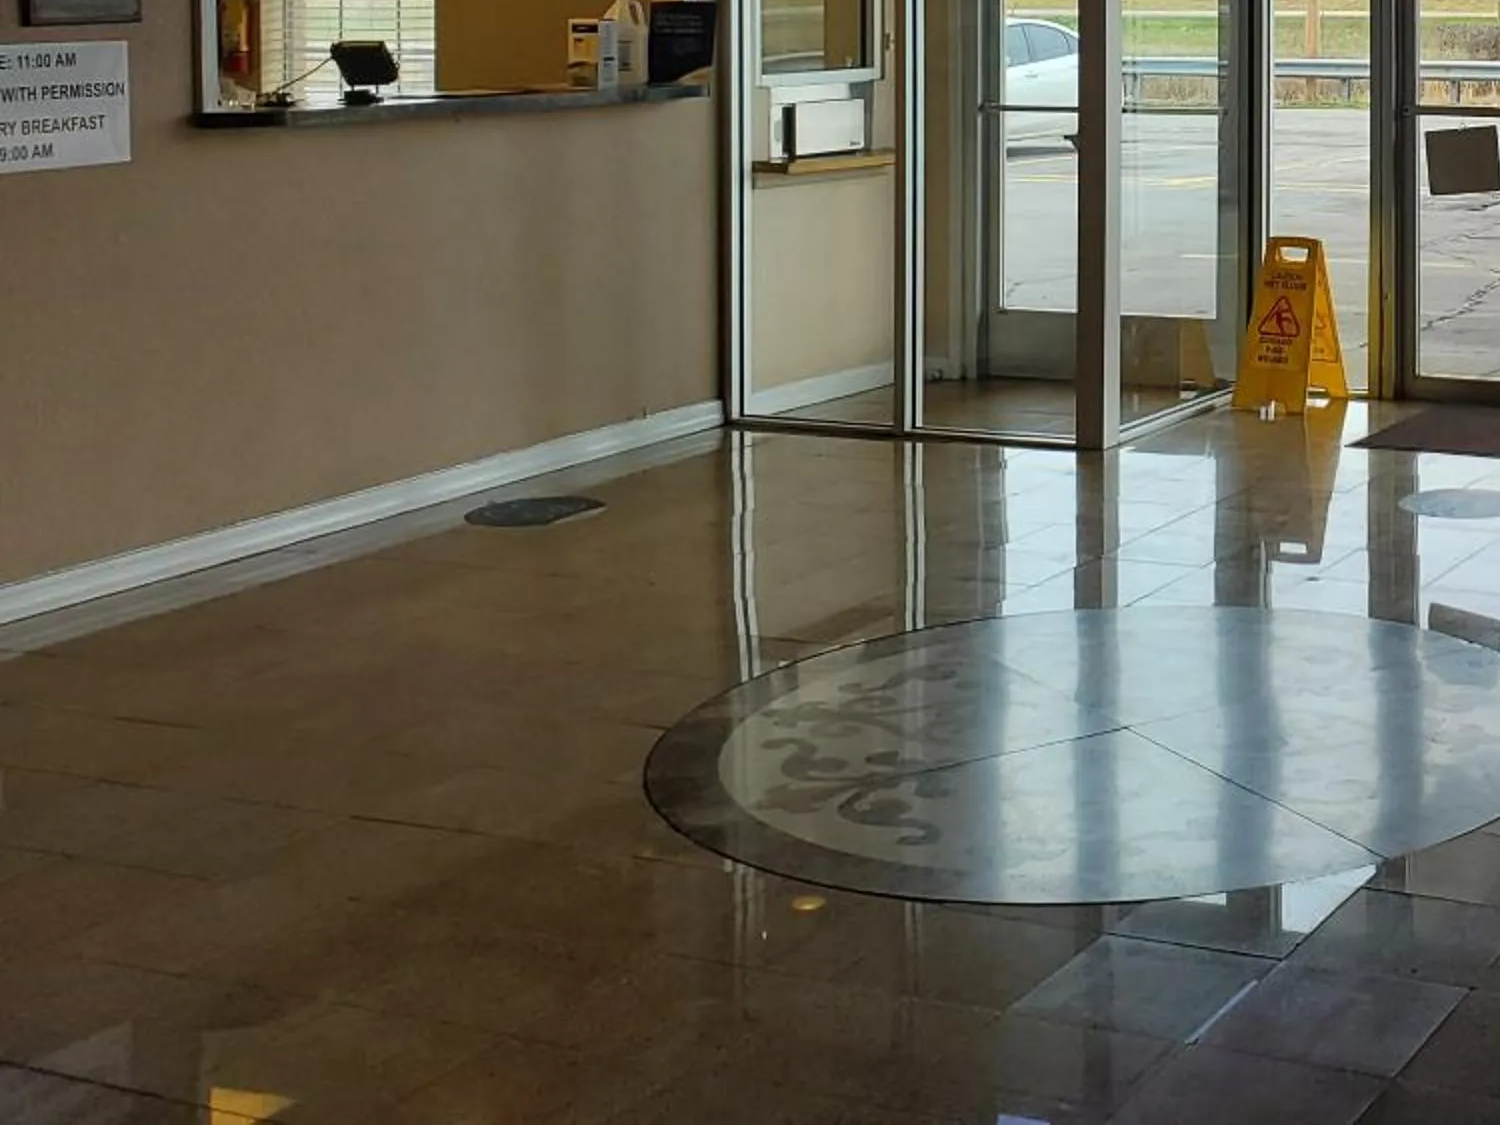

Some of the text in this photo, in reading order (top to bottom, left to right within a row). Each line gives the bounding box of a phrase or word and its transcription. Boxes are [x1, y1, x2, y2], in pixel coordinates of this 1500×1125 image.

[17, 53, 52, 69] 11:00
[55, 52, 77, 68] AM
[1, 82, 125, 104] WITH PERMISSION
[21, 114, 106, 136] BREAKFAST
[32, 143, 54, 160] AM
